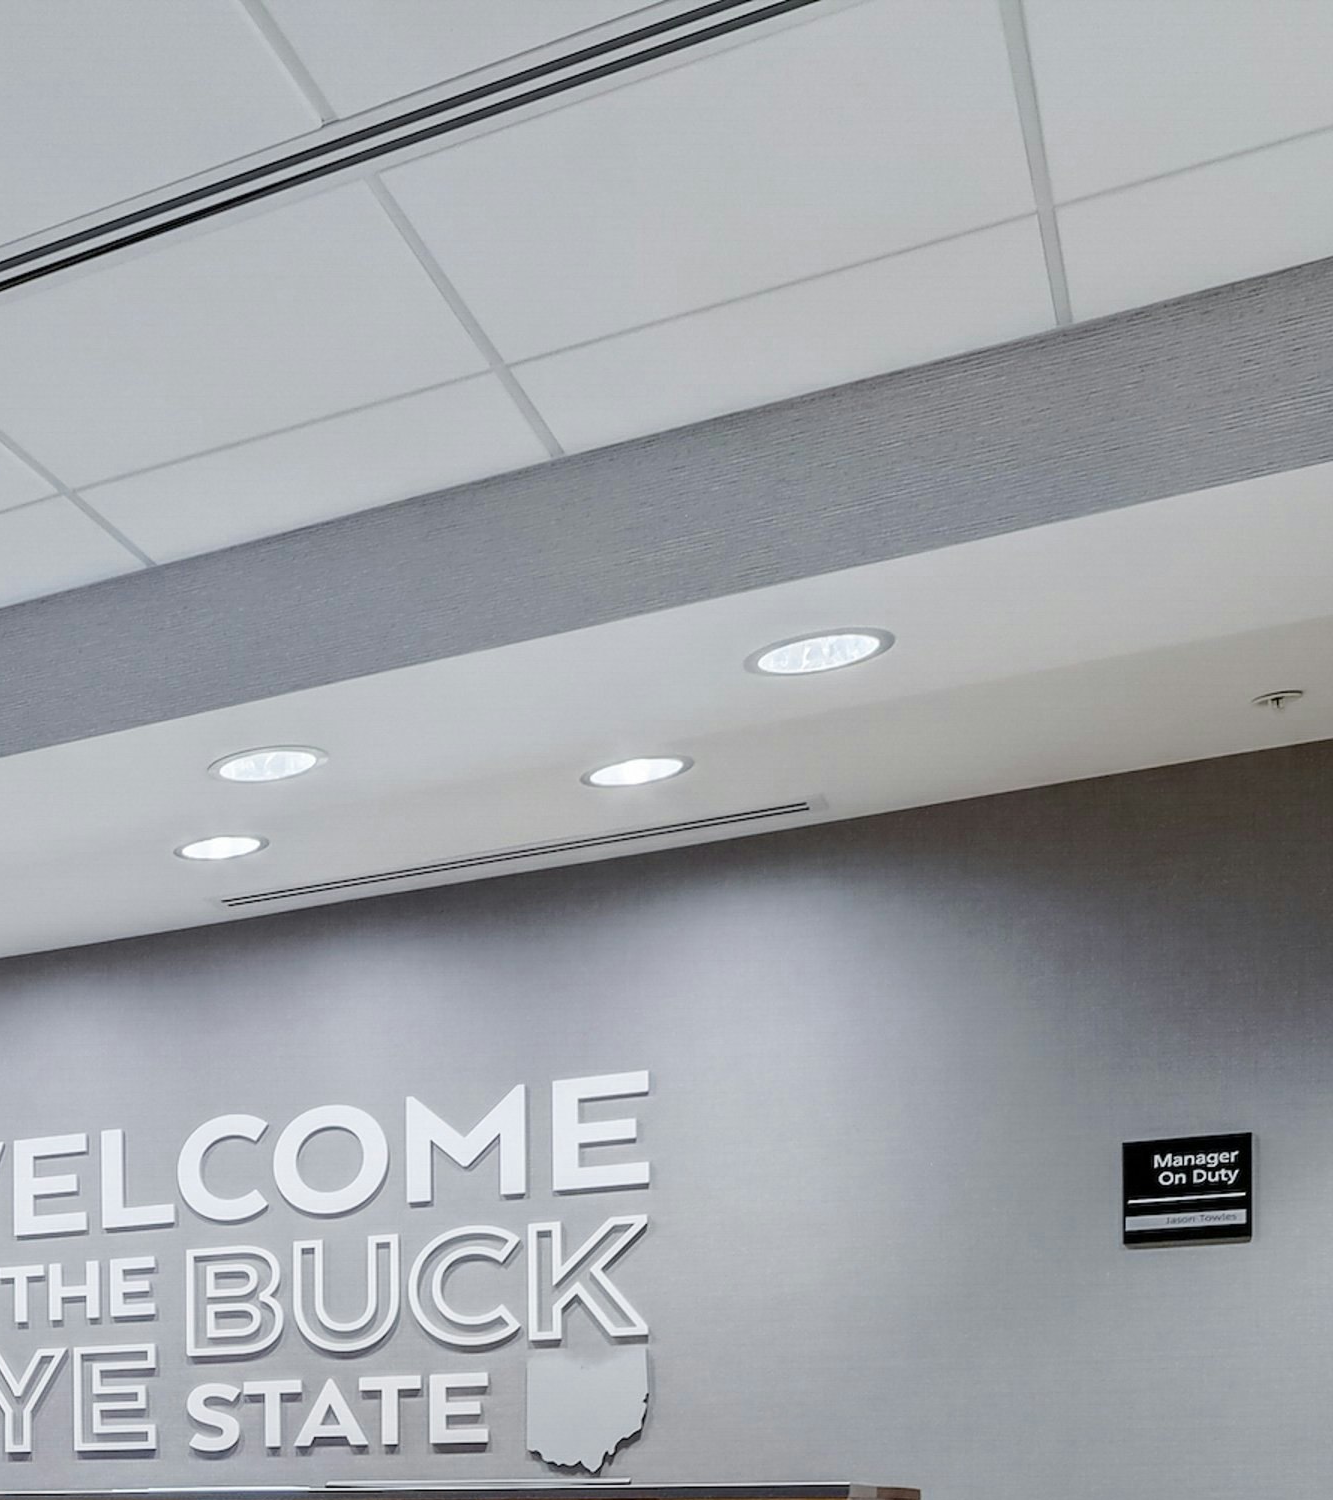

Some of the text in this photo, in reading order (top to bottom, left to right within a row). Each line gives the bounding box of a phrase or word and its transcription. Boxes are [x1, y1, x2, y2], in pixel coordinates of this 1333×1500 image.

[1153, 1150, 1240, 1168] Manager
[1158, 1168, 1240, 1186] On Duty
[185, 1214, 650, 1358] BUCK
[187, 1372, 490, 1453] STATE
